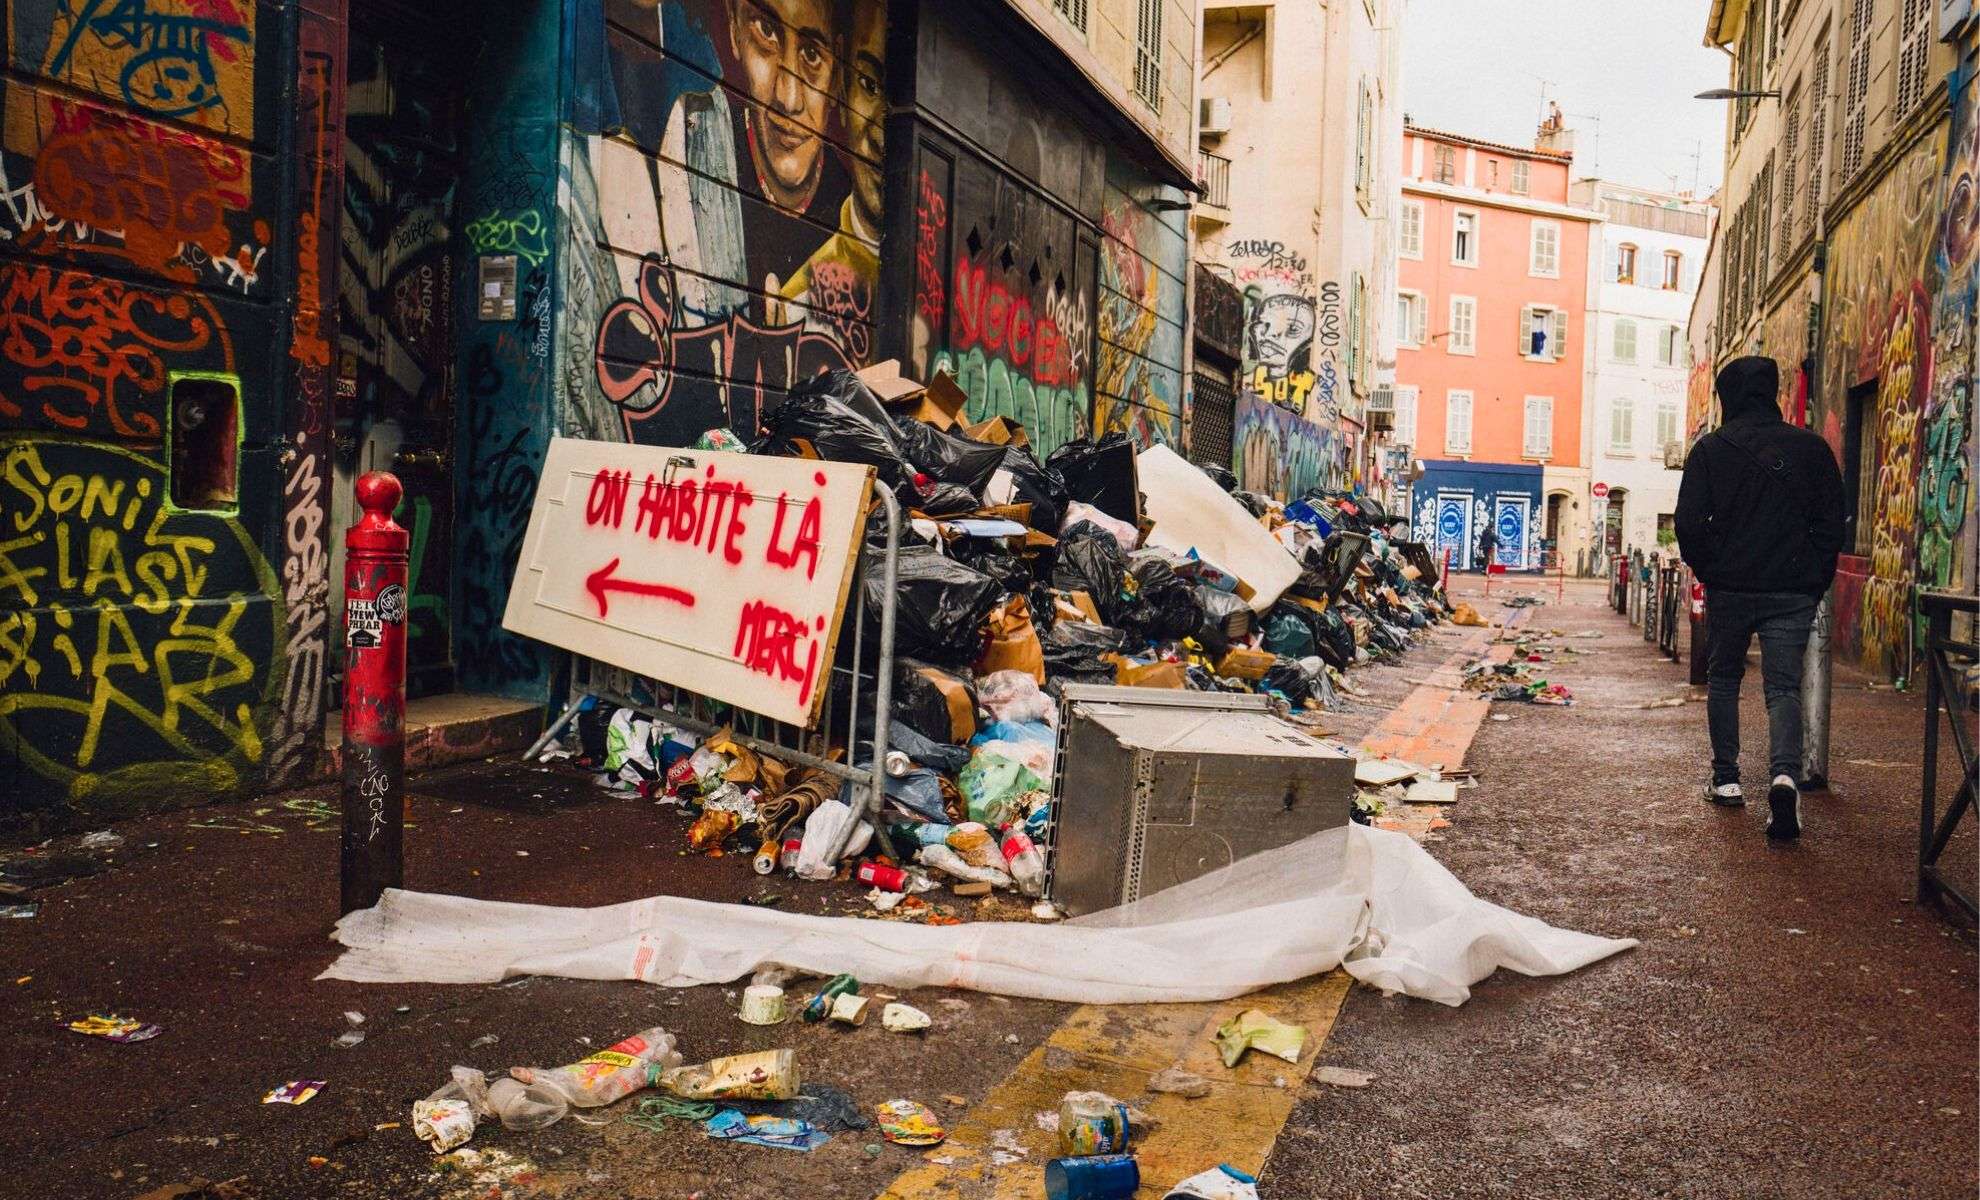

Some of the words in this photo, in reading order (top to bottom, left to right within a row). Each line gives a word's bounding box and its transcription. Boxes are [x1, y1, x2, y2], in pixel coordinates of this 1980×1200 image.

[586, 469, 631, 529] ON
[767, 471, 826, 580] LÀ
[349, 609, 375, 620] STEW
